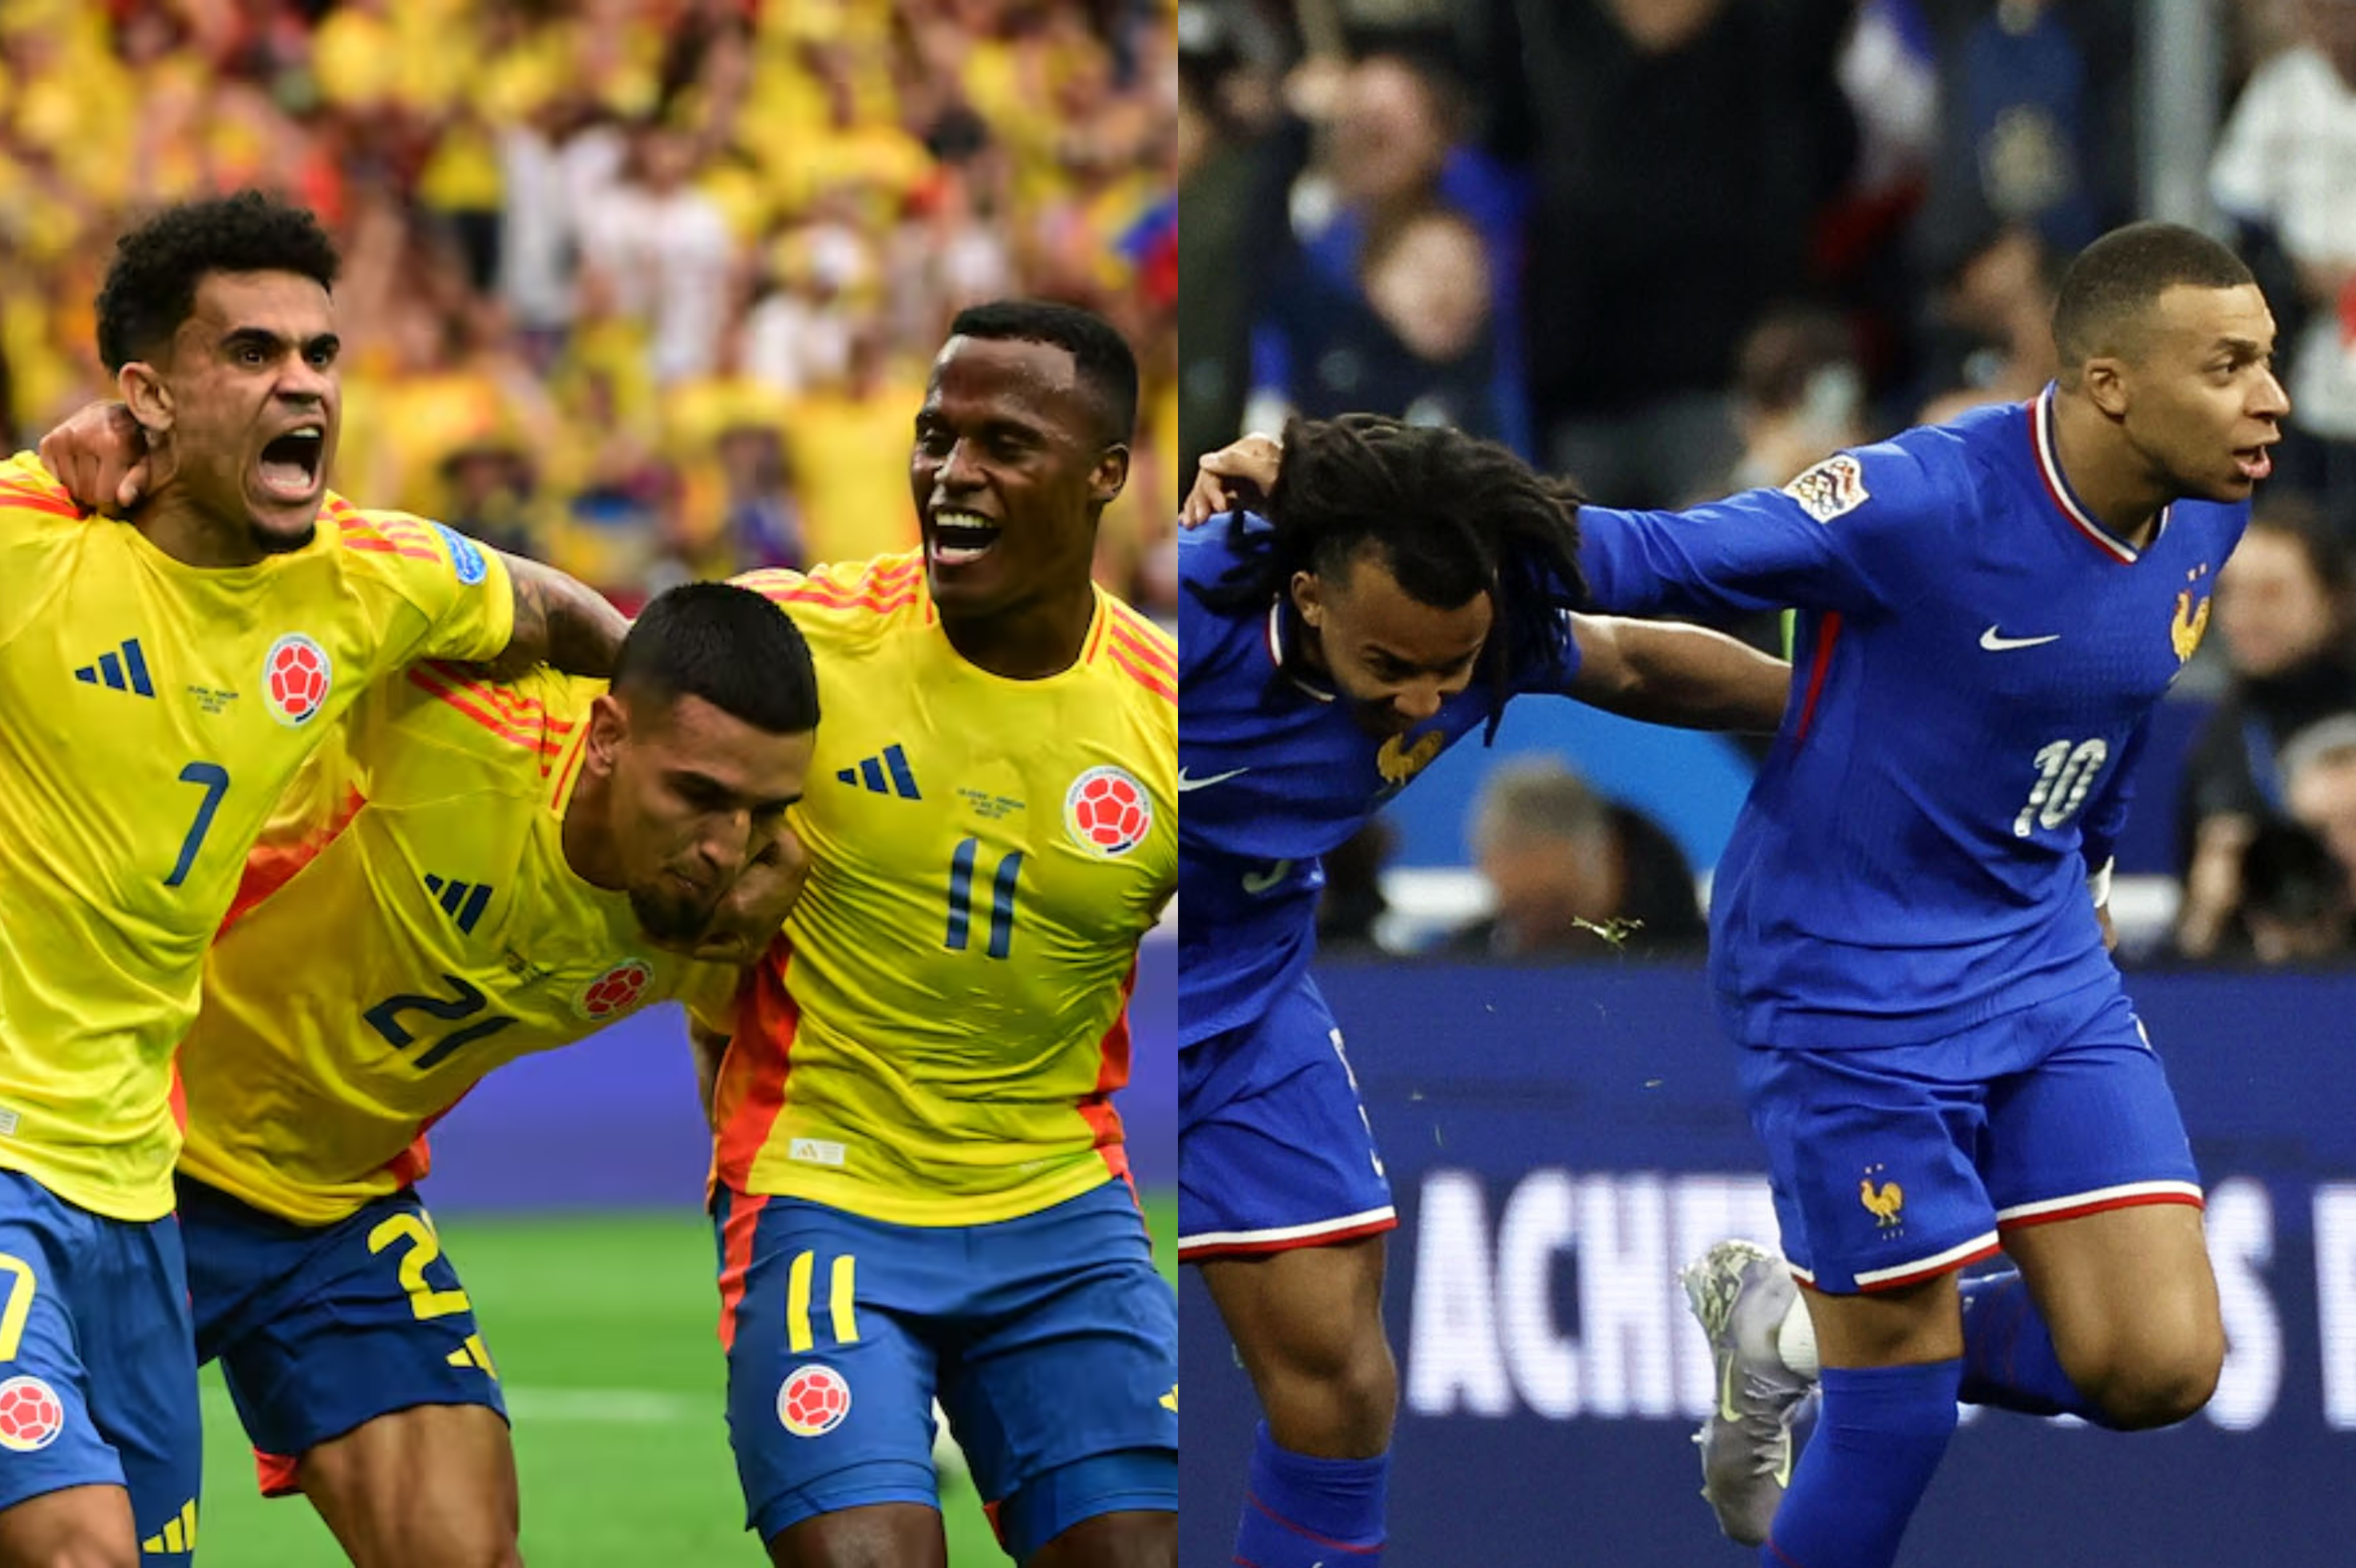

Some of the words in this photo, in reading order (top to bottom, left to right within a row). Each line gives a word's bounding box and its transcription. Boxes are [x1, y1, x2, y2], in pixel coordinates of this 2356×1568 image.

[163, 760, 230, 888] 7
[2013, 738, 2107, 837] 10
[944, 835, 1025, 961] 11
[362, 973, 520, 1070] 21
[0, 1251, 37, 1363] 7
[368, 1207, 472, 1321] 2
[787, 1249, 860, 1355] 11
